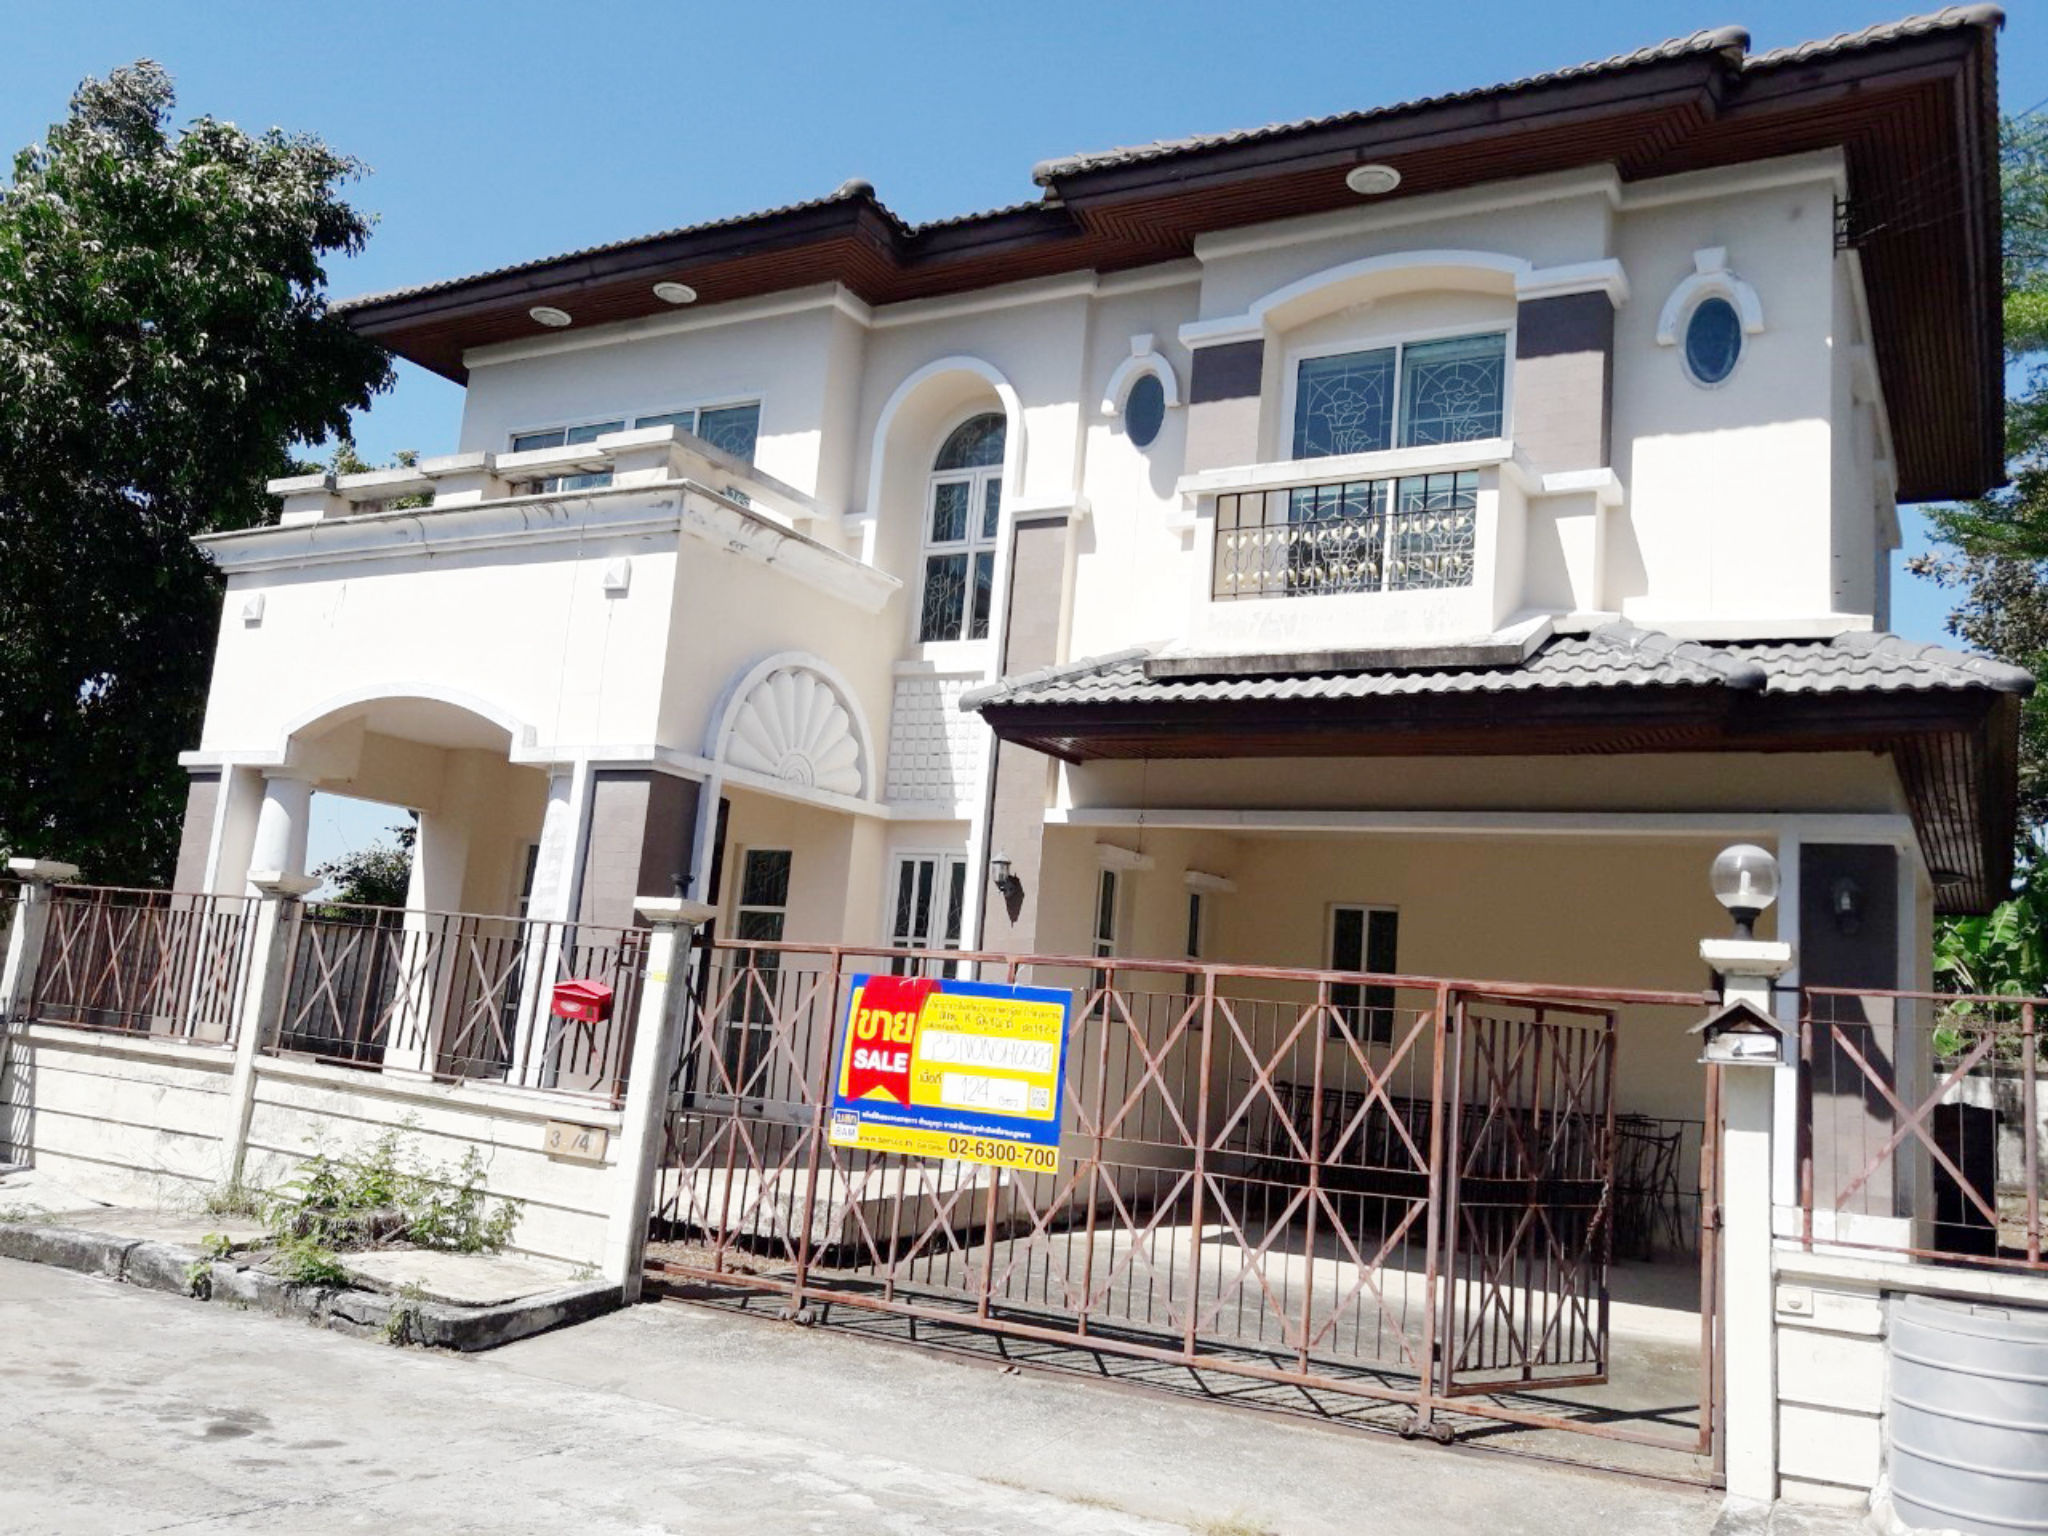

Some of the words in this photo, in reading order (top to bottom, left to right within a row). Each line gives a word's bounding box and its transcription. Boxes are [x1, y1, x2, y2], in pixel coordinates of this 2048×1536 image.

[857, 1008, 916, 1043] ขาย
[853, 1048, 909, 1074] SALE
[961, 1076, 991, 1103] 124
[835, 1126, 856, 1137] BAM
[949, 1137, 1056, 1168] 02-6300-700
